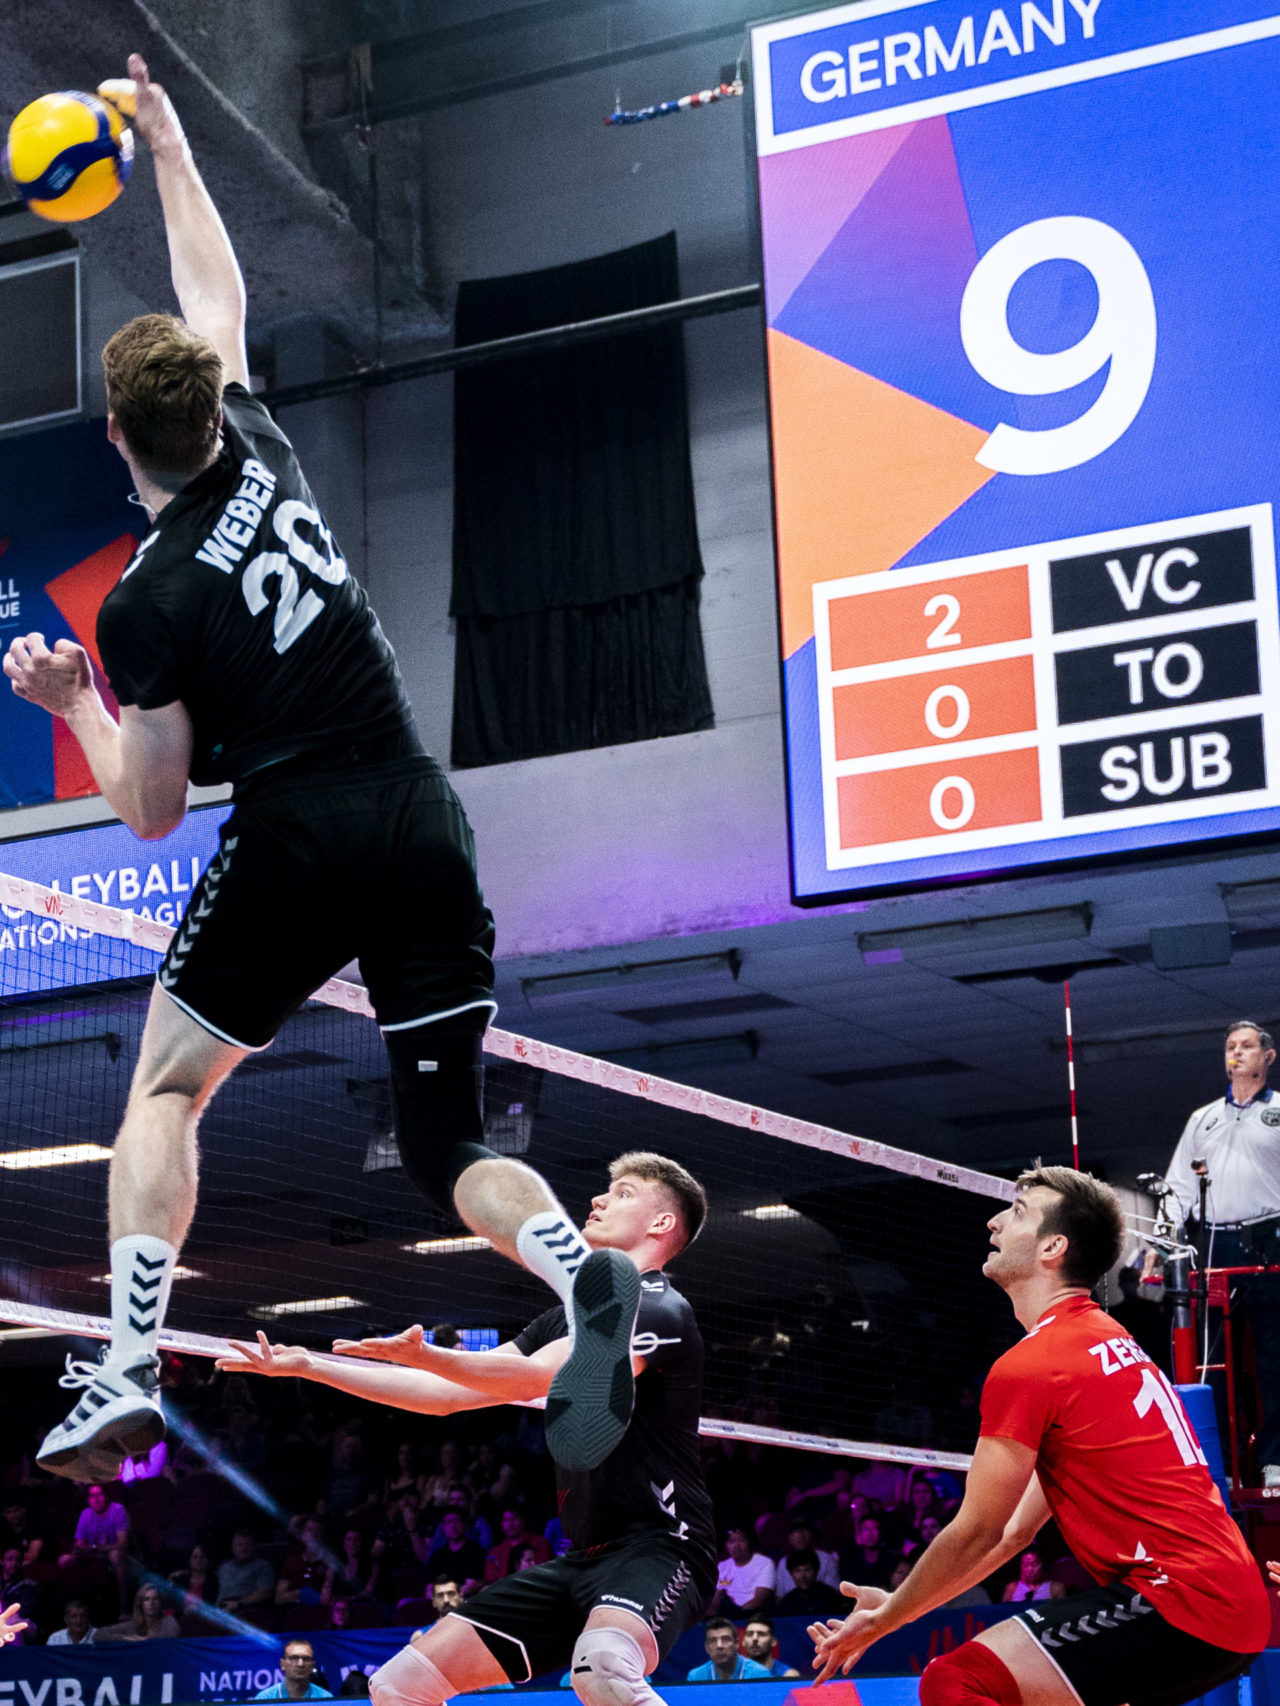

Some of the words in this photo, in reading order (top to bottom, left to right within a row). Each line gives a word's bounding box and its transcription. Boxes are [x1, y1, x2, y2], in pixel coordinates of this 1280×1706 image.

[800, 0, 1102, 103] GERMANY
[960, 216, 1157, 476] 9
[195, 458, 277, 574] WEBER
[242, 499, 347, 655] 20
[923, 594, 962, 649] 2
[1106, 548, 1200, 610] VC
[924, 684, 970, 739] 0
[1114, 643, 1202, 704] TO
[929, 775, 975, 830] 0
[1101, 733, 1231, 801] SUB
